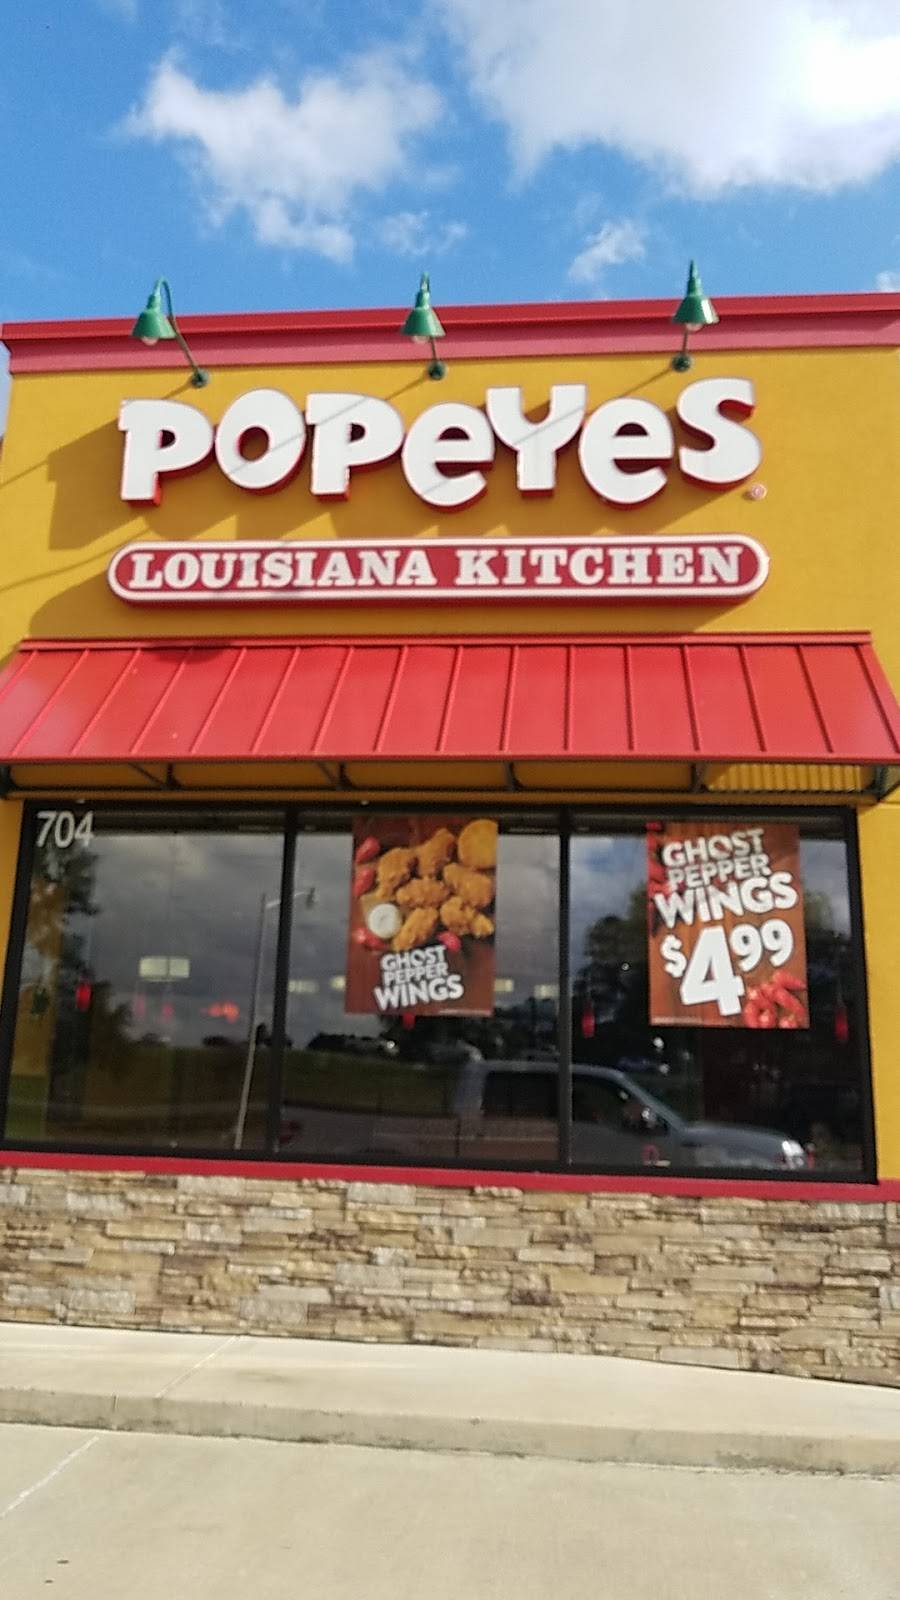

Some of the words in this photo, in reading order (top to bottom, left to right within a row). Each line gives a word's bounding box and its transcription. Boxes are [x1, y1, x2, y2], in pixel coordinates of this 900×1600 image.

[129, 550, 437, 591] LOUISIANA
[455, 545, 742, 586] KITCHEN
[36, 810, 94, 848] 704
[661, 827, 764, 868] GHOST
[667, 853, 772, 891] PEPPER
[654, 871, 798, 929] WINGS
[380, 944, 447, 972] GHOST
[383, 961, 449, 986] PEPPER
[373, 974, 465, 1011] WINGS
